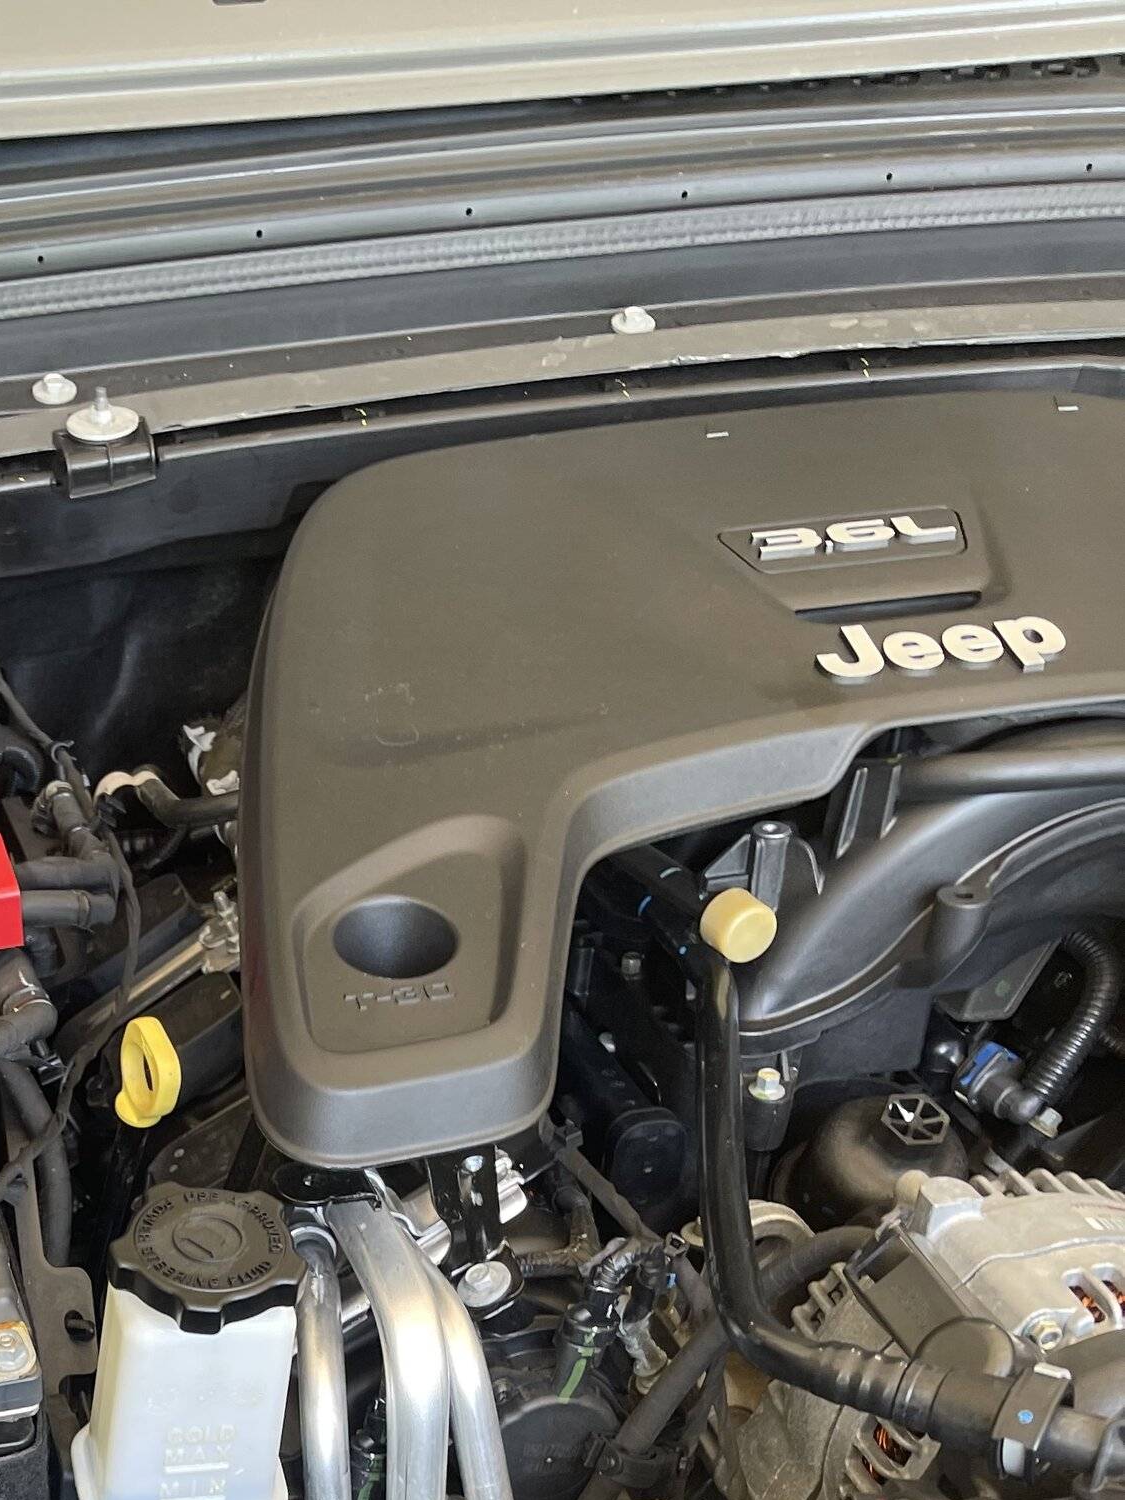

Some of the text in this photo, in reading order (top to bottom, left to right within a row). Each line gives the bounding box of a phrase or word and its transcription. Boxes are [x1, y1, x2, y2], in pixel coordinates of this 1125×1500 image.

[751, 515, 958, 561] 3.6L
[815, 615, 1066, 682] Jeep
[165, 1444, 231, 1462] MAX
[159, 1478, 226, 1497] MIN
